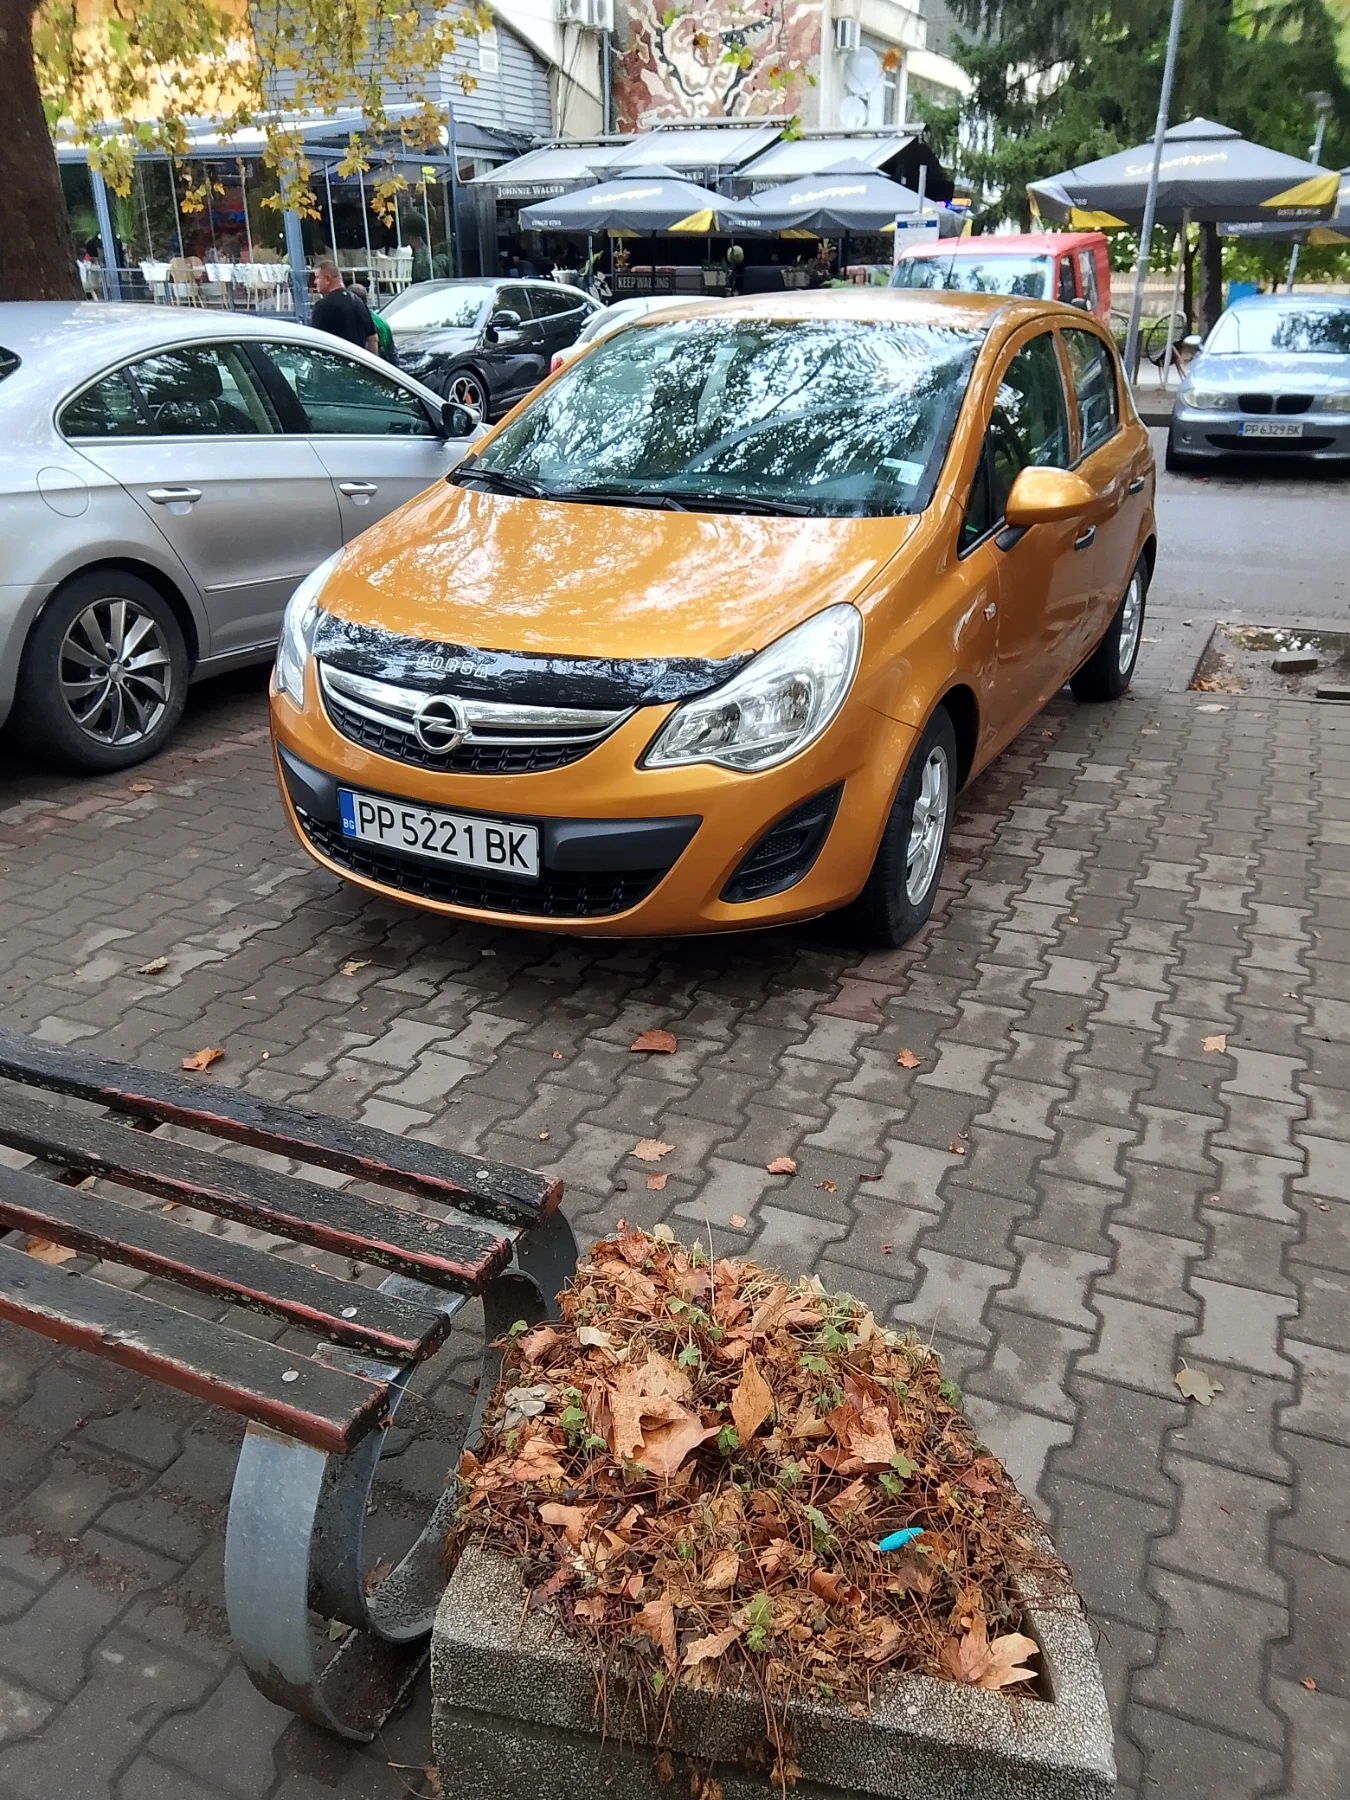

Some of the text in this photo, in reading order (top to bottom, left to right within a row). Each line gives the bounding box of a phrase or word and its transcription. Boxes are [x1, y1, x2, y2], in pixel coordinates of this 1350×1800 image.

[497, 185, 565, 197] JOHNNIE WALKER
[618, 276, 669, 288] KEEP WALING
[1245, 424, 1259, 434] PP
[1260, 425, 1285, 435] 6329
[1287, 425, 1300, 435] BK
[416, 654, 489, 679] CORSA
[343, 800, 530, 869] BG PP 5221 BK
